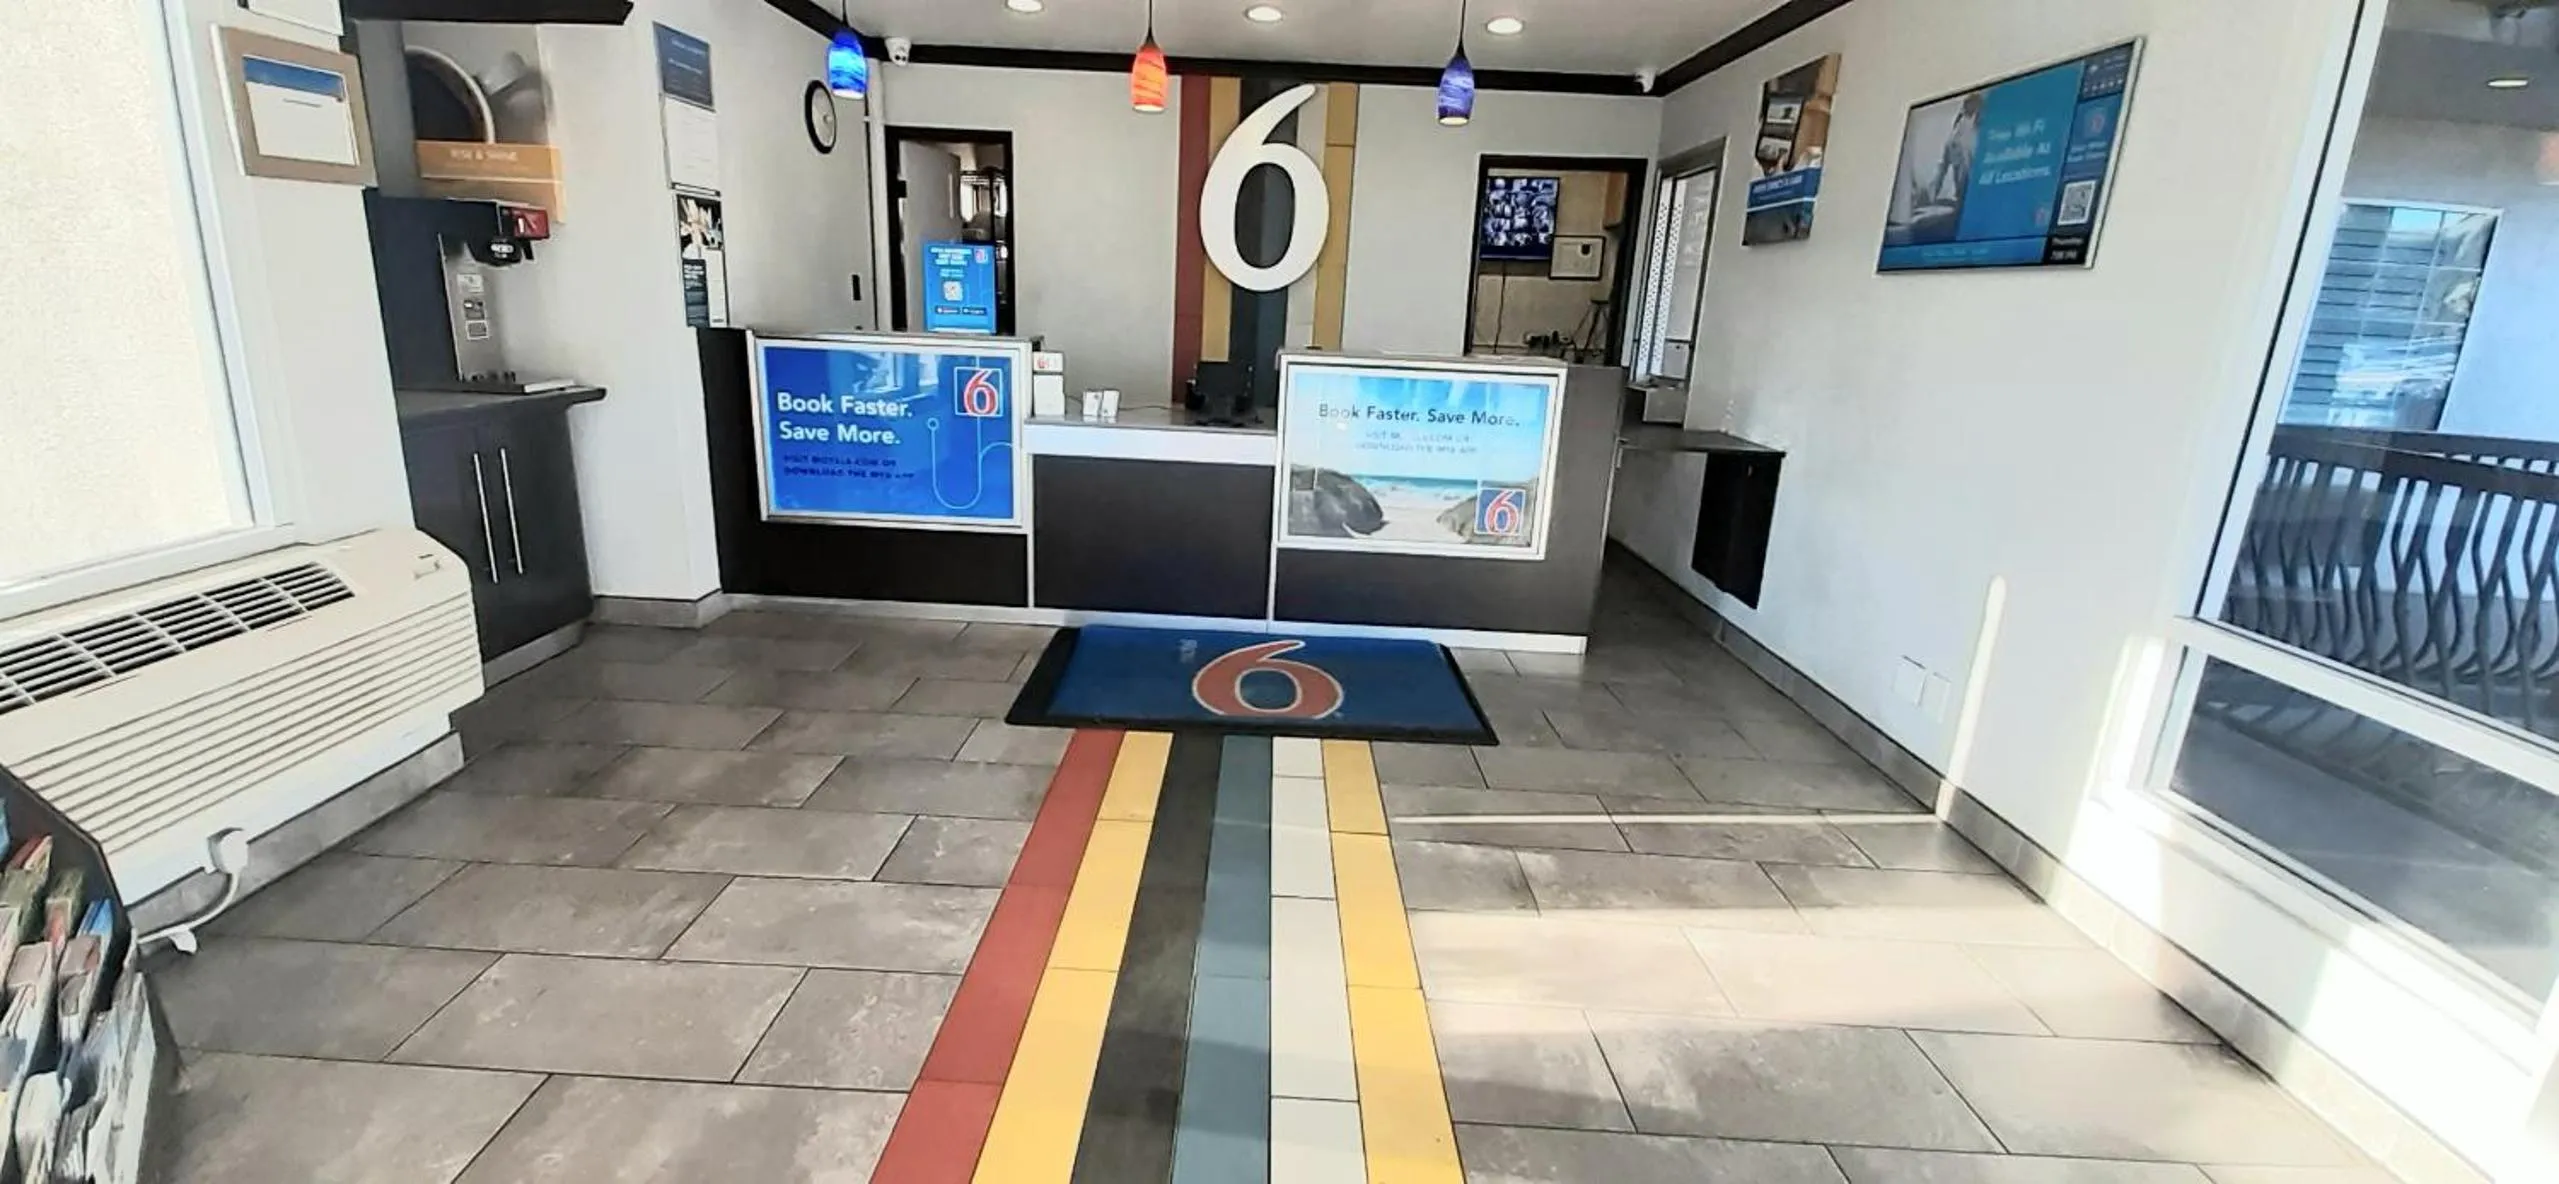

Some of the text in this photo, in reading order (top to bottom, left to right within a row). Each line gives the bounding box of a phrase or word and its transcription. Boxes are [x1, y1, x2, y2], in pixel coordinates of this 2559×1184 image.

[1200, 83, 1330, 292] 6
[777, 392, 912, 417] Book Faster.
[963, 368, 999, 416] 6
[1318, 403, 1520, 427] Book Faster. Save More.
[779, 420, 900, 444] Save More.
[1484, 489, 1520, 535] 6
[1192, 640, 1343, 719] 6
